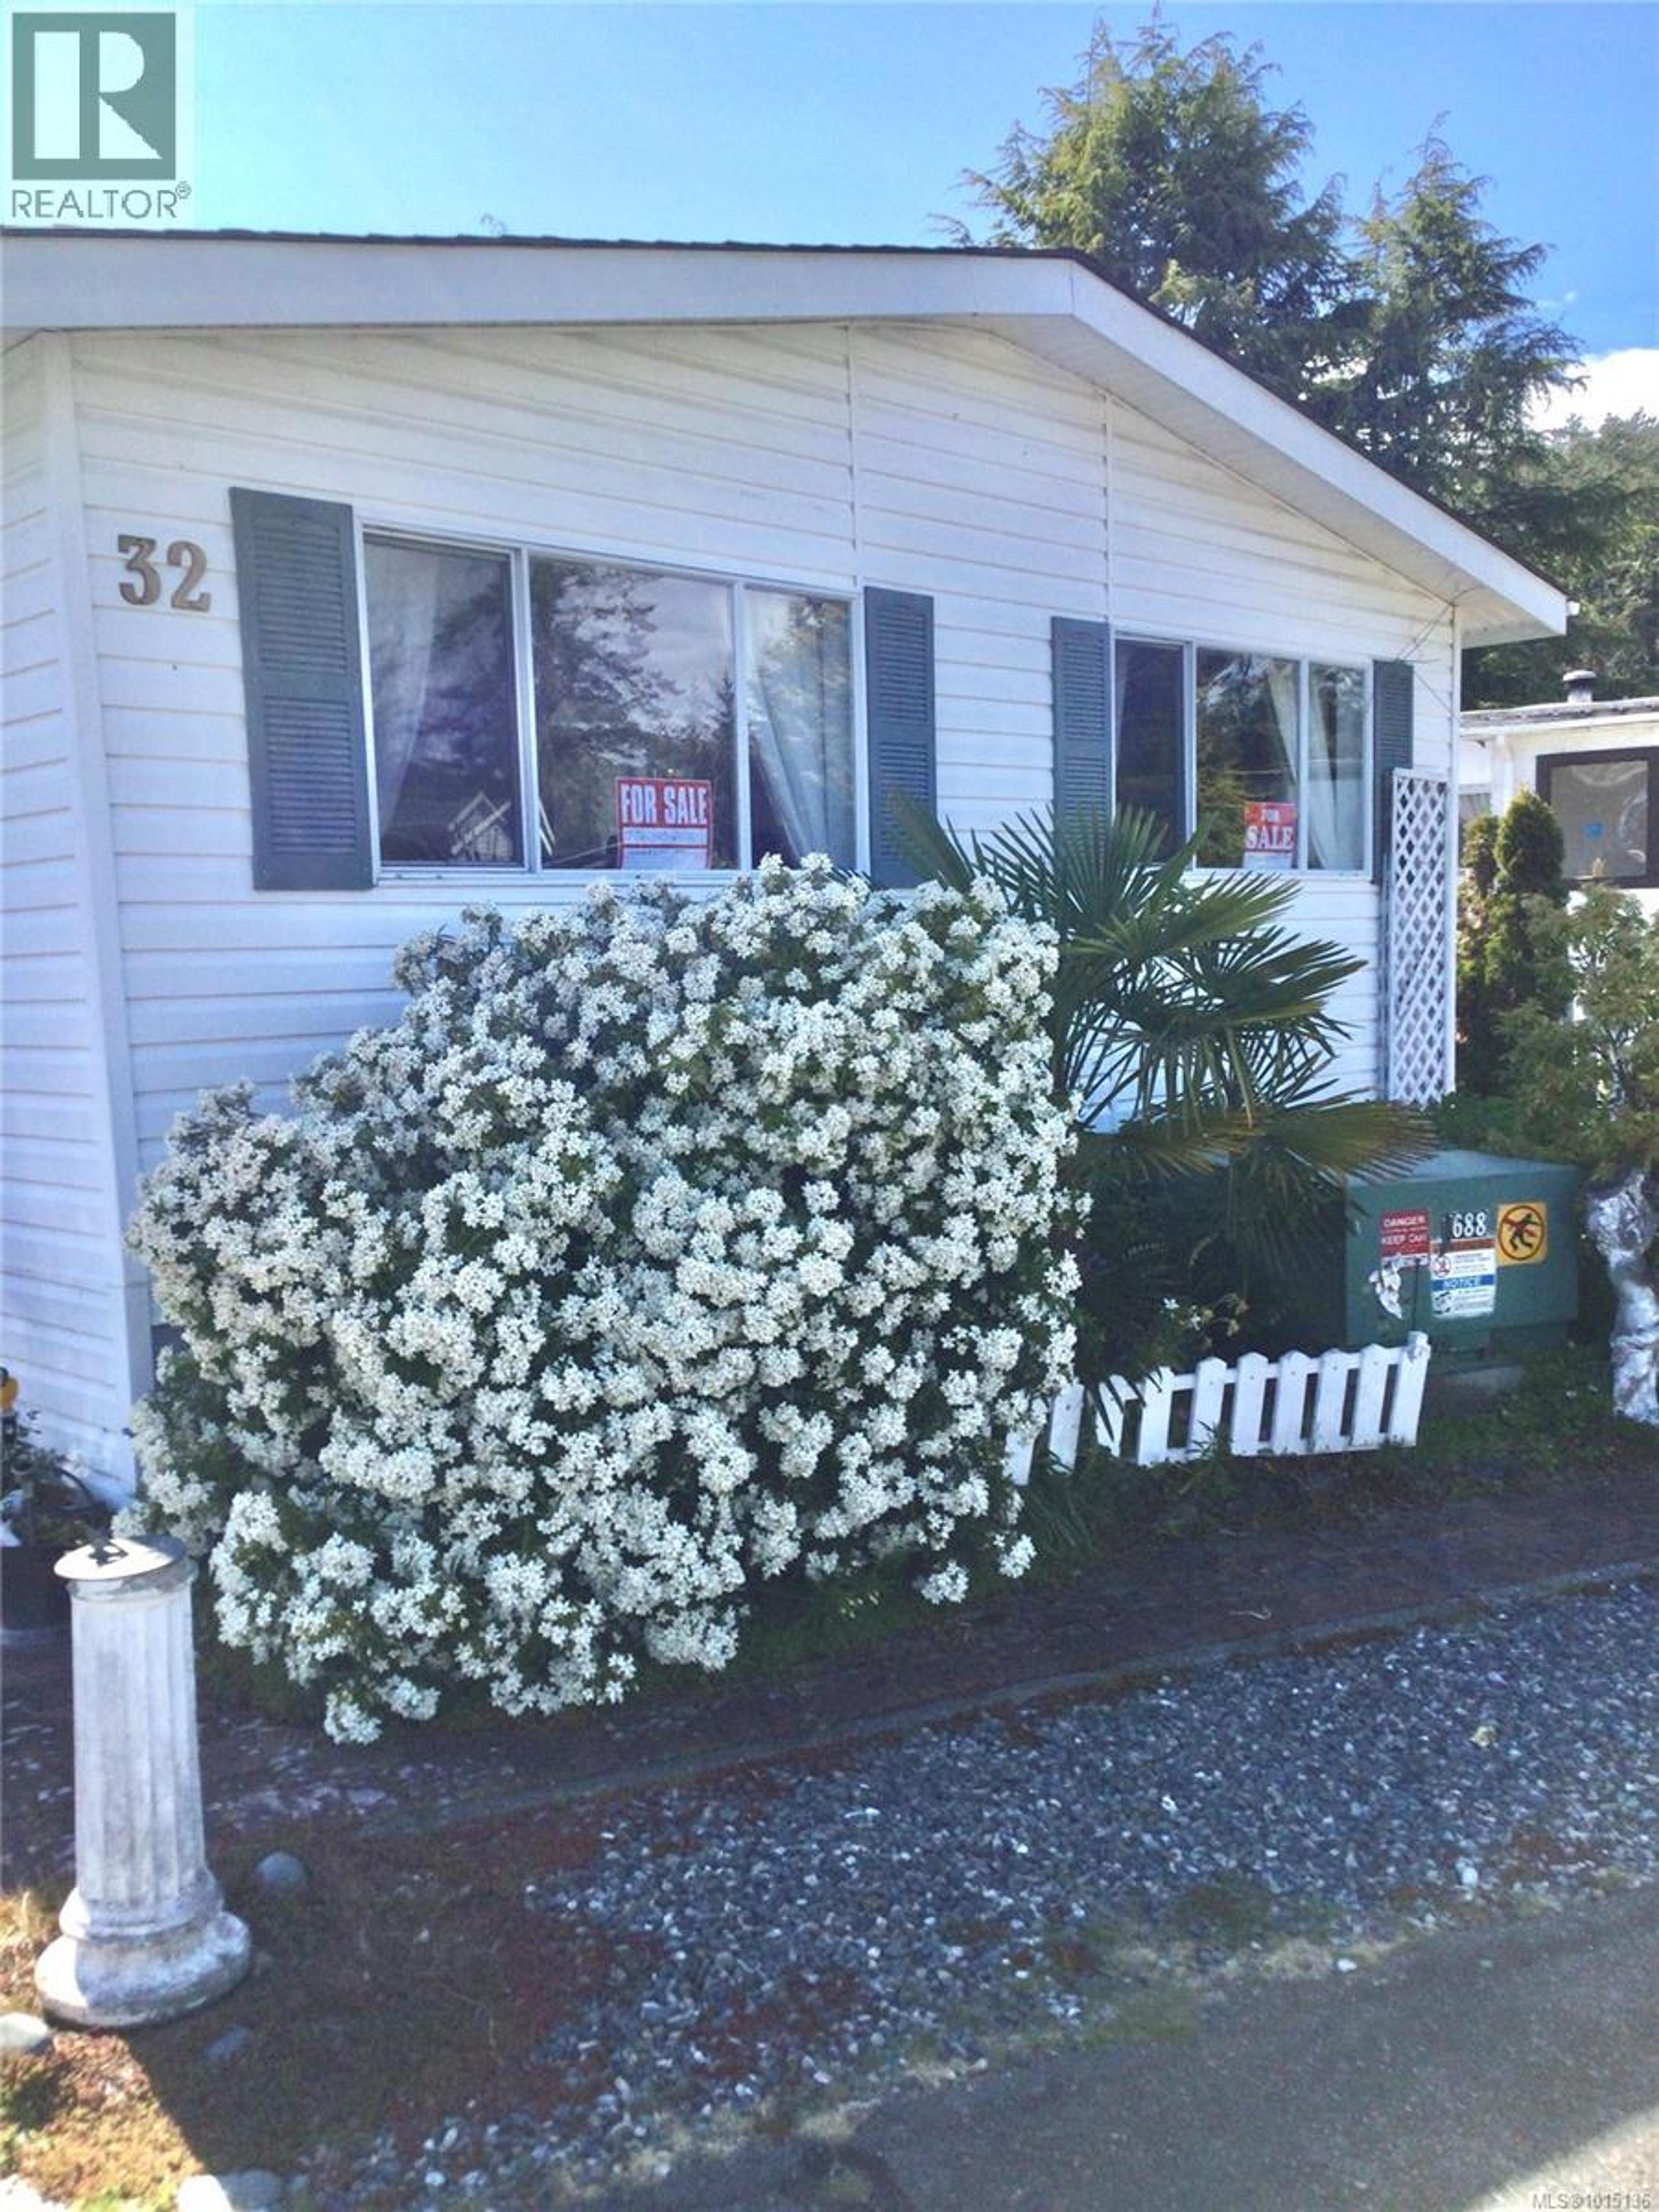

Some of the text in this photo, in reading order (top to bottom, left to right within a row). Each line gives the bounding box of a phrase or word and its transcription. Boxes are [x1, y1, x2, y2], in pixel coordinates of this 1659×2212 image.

[118, 534, 211, 612] 32
[620, 783, 707, 825] FOR SALE
[1261, 809, 1280, 823] FOR
[1246, 825, 1295, 849] SALE
[1384, 1215, 1425, 1227] DANGER
[1452, 1212, 1486, 1238] 688
[1381, 1234, 1405, 1245] KEEP
[1443, 1275, 1480, 1289] NOTICE
